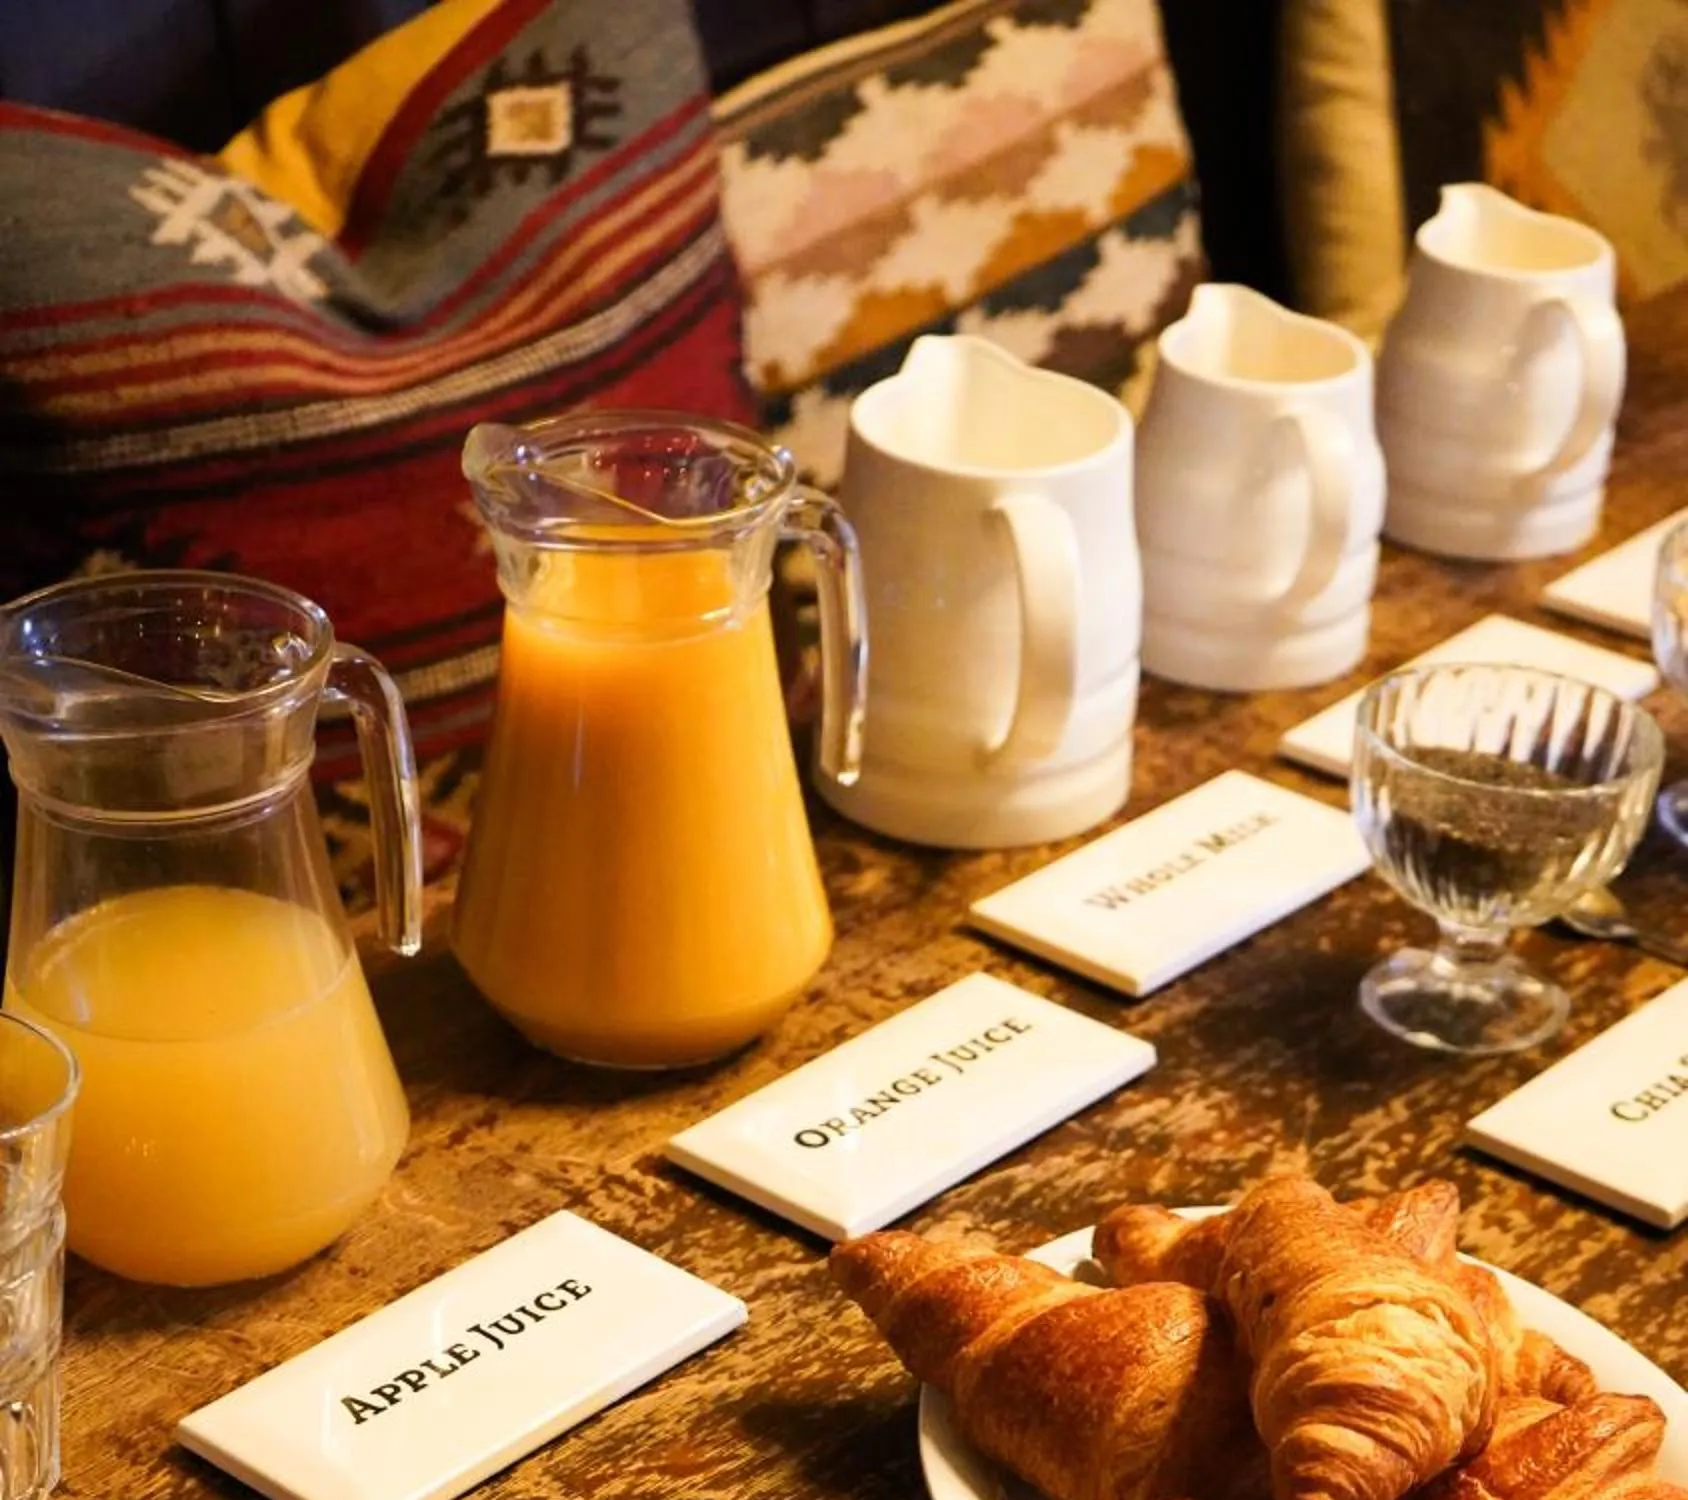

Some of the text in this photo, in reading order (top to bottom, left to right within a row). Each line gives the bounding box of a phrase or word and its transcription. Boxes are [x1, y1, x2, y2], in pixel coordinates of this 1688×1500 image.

[794, 1018, 1032, 1148] ORANGE JUICE
[341, 1279, 592, 1424] APPLE JUICE
